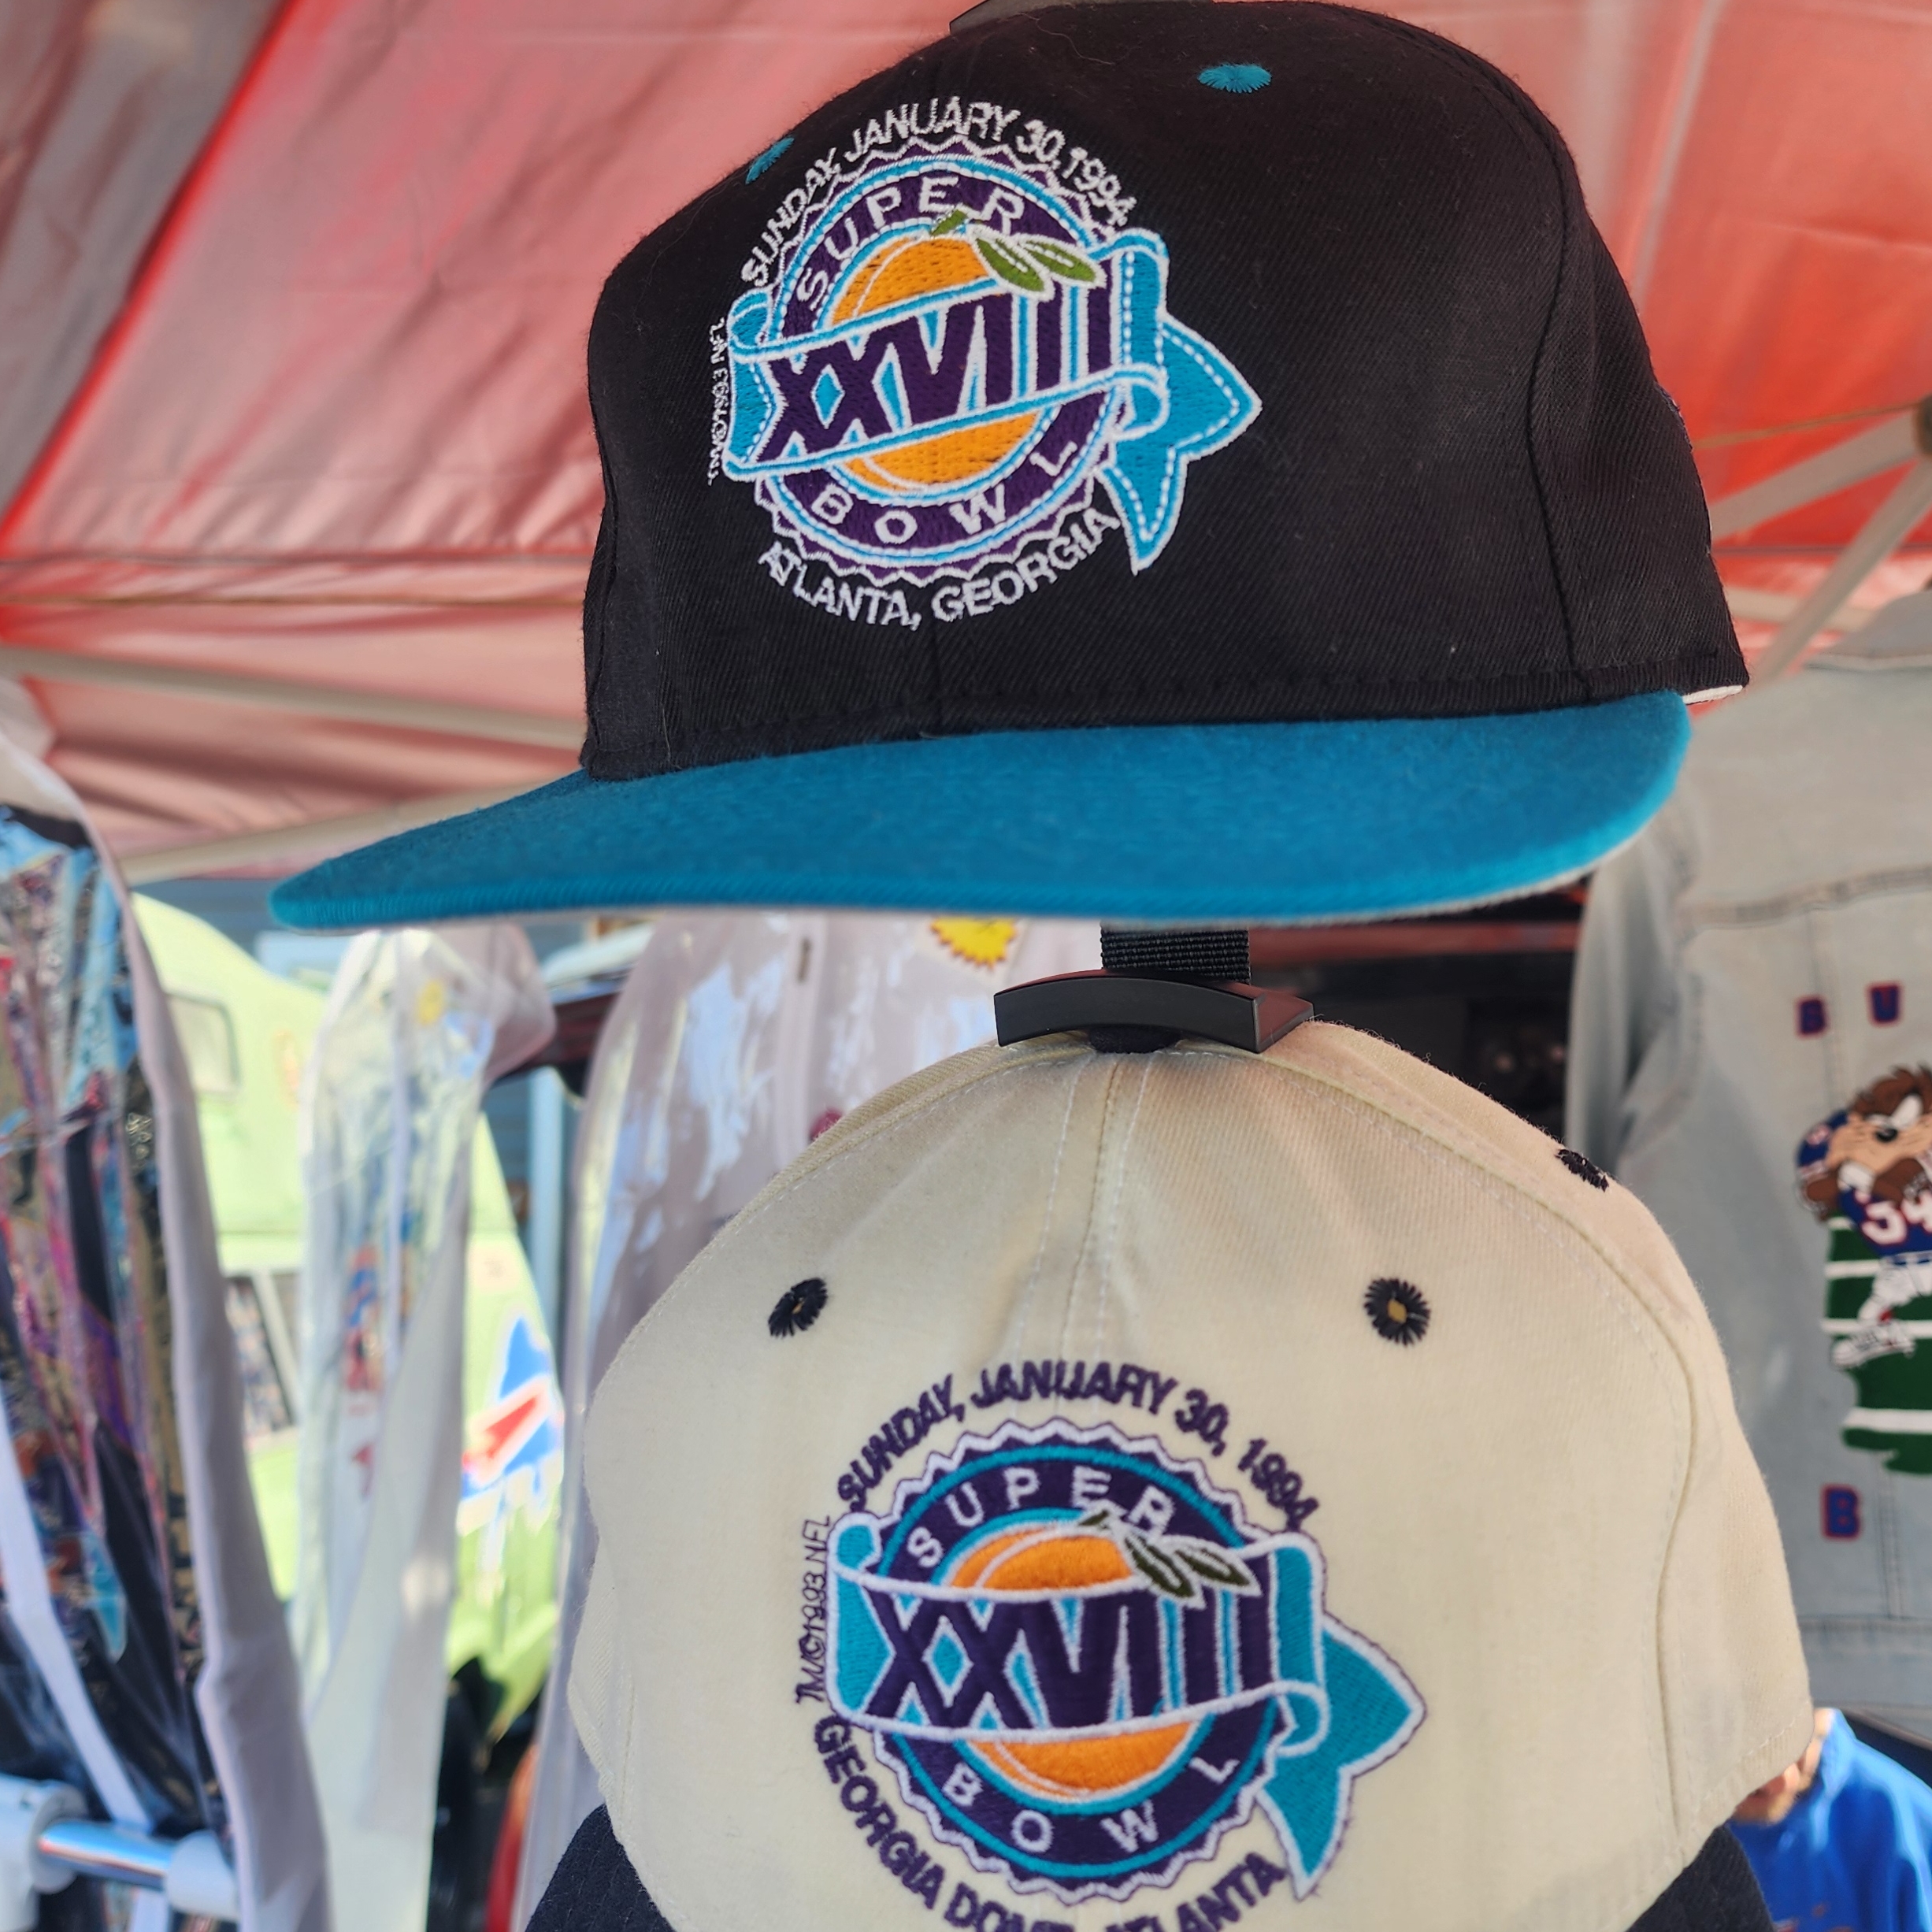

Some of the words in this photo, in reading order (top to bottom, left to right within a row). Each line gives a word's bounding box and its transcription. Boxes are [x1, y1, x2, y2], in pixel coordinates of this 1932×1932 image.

[844, 95, 1022, 162] JANUARY
[795, 176, 1025, 311] SUPER
[756, 258, 1114, 462] XXVIII
[810, 441, 1078, 545] BOWL
[931, 506, 1122, 622] GEORGIA
[836, 1372, 966, 1514] SUNDAY,
[970, 1359, 1180, 1415] JANUARY
[1174, 1387, 1229, 1457] 30,
[1237, 1437, 1320, 1531] 1994
[801, 1514, 831, 1565] NFL
[907, 1465, 1175, 1569] SUPER
[1820, 1484, 1863, 1541] B
[862, 1553, 1273, 1731] XXVIII
[814, 1714, 945, 1910] GEORGIA
[941, 1756, 1242, 1853] BOWL
